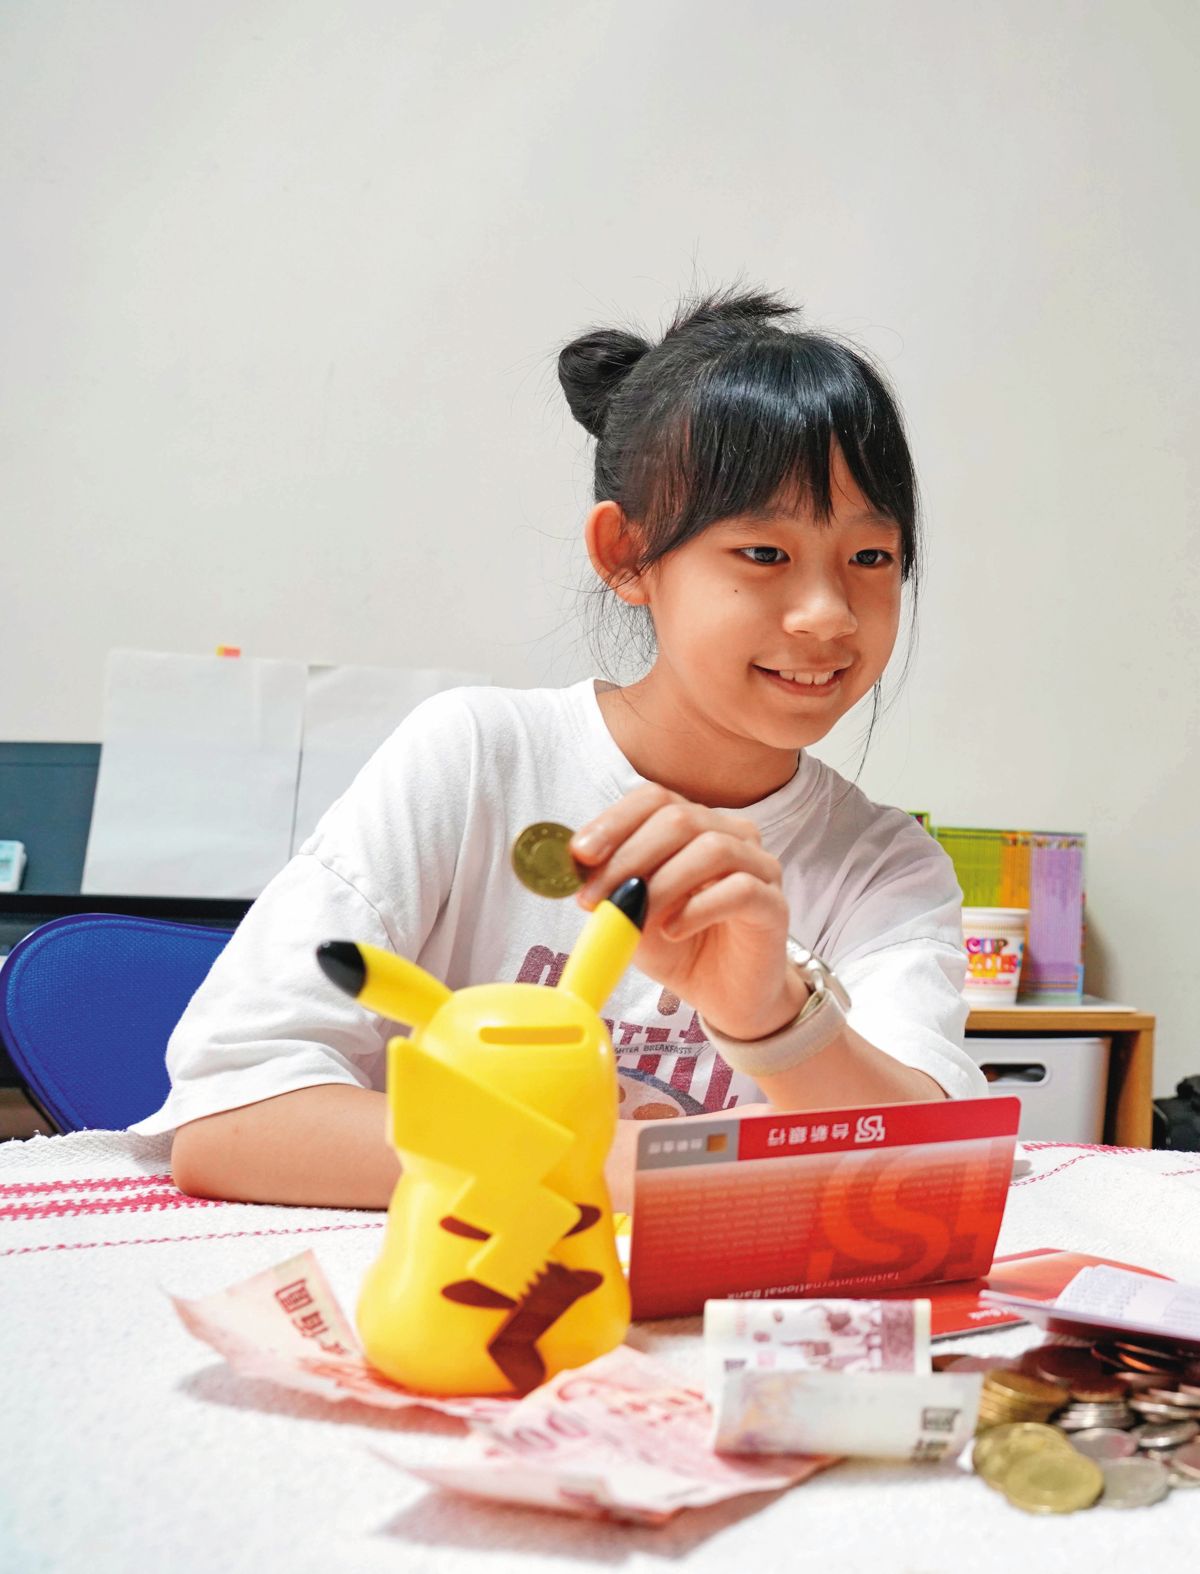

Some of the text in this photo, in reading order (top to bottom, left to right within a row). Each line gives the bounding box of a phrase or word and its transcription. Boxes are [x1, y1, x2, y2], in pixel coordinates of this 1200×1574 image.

[767, 1123, 850, 1146] 台新銀行
[727, 1271, 900, 1300] Taishin International Bank
